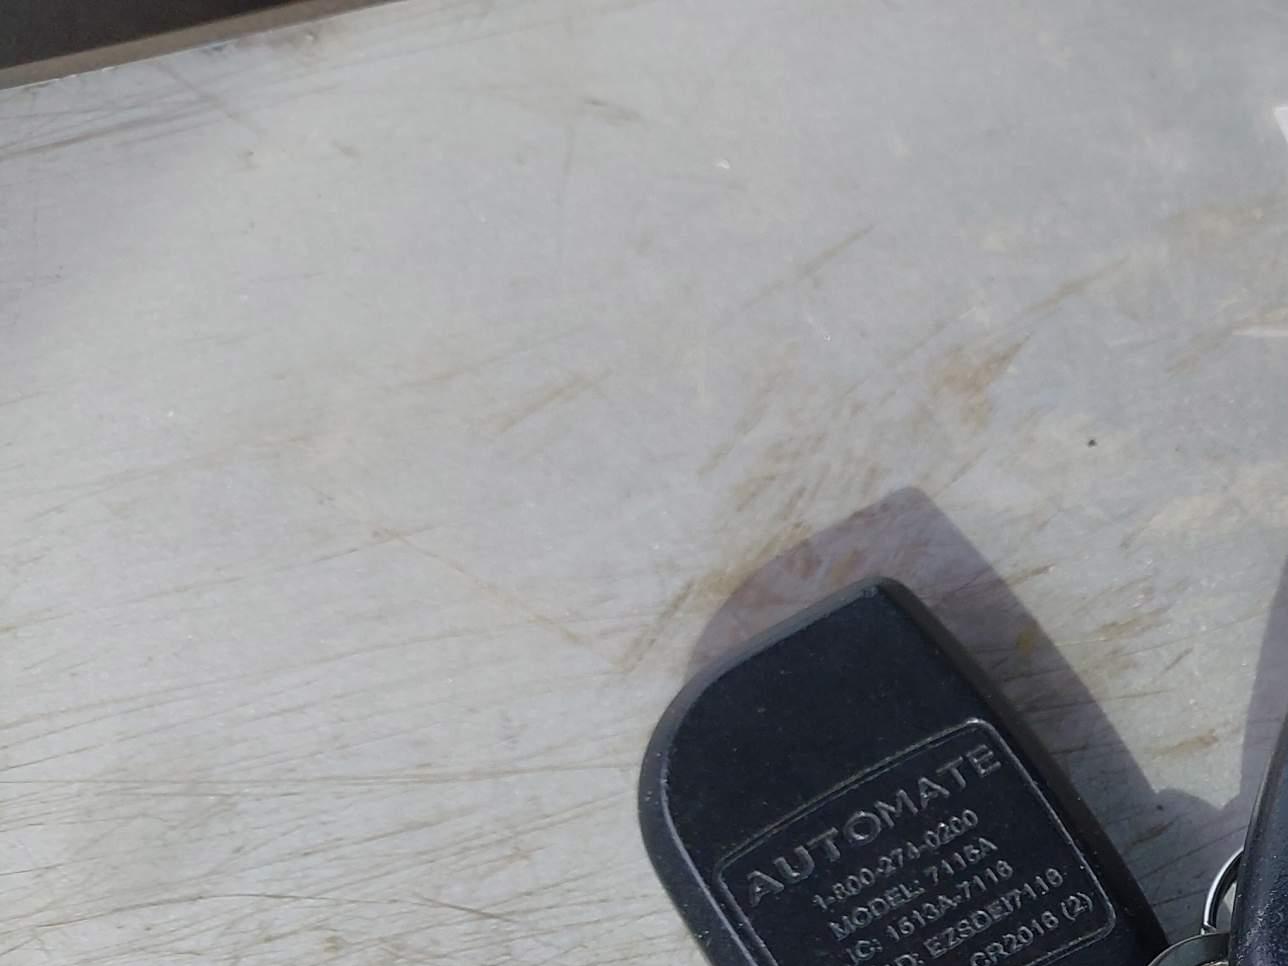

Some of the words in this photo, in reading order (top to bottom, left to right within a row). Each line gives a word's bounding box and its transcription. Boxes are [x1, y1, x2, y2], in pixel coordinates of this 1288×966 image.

[747, 744, 1001, 908] AUTOMATE
[812, 809, 979, 911] 1-800-274-0200
[829, 879, 925, 942] MODEL:
[1060, 891, 1094, 922] (2)
